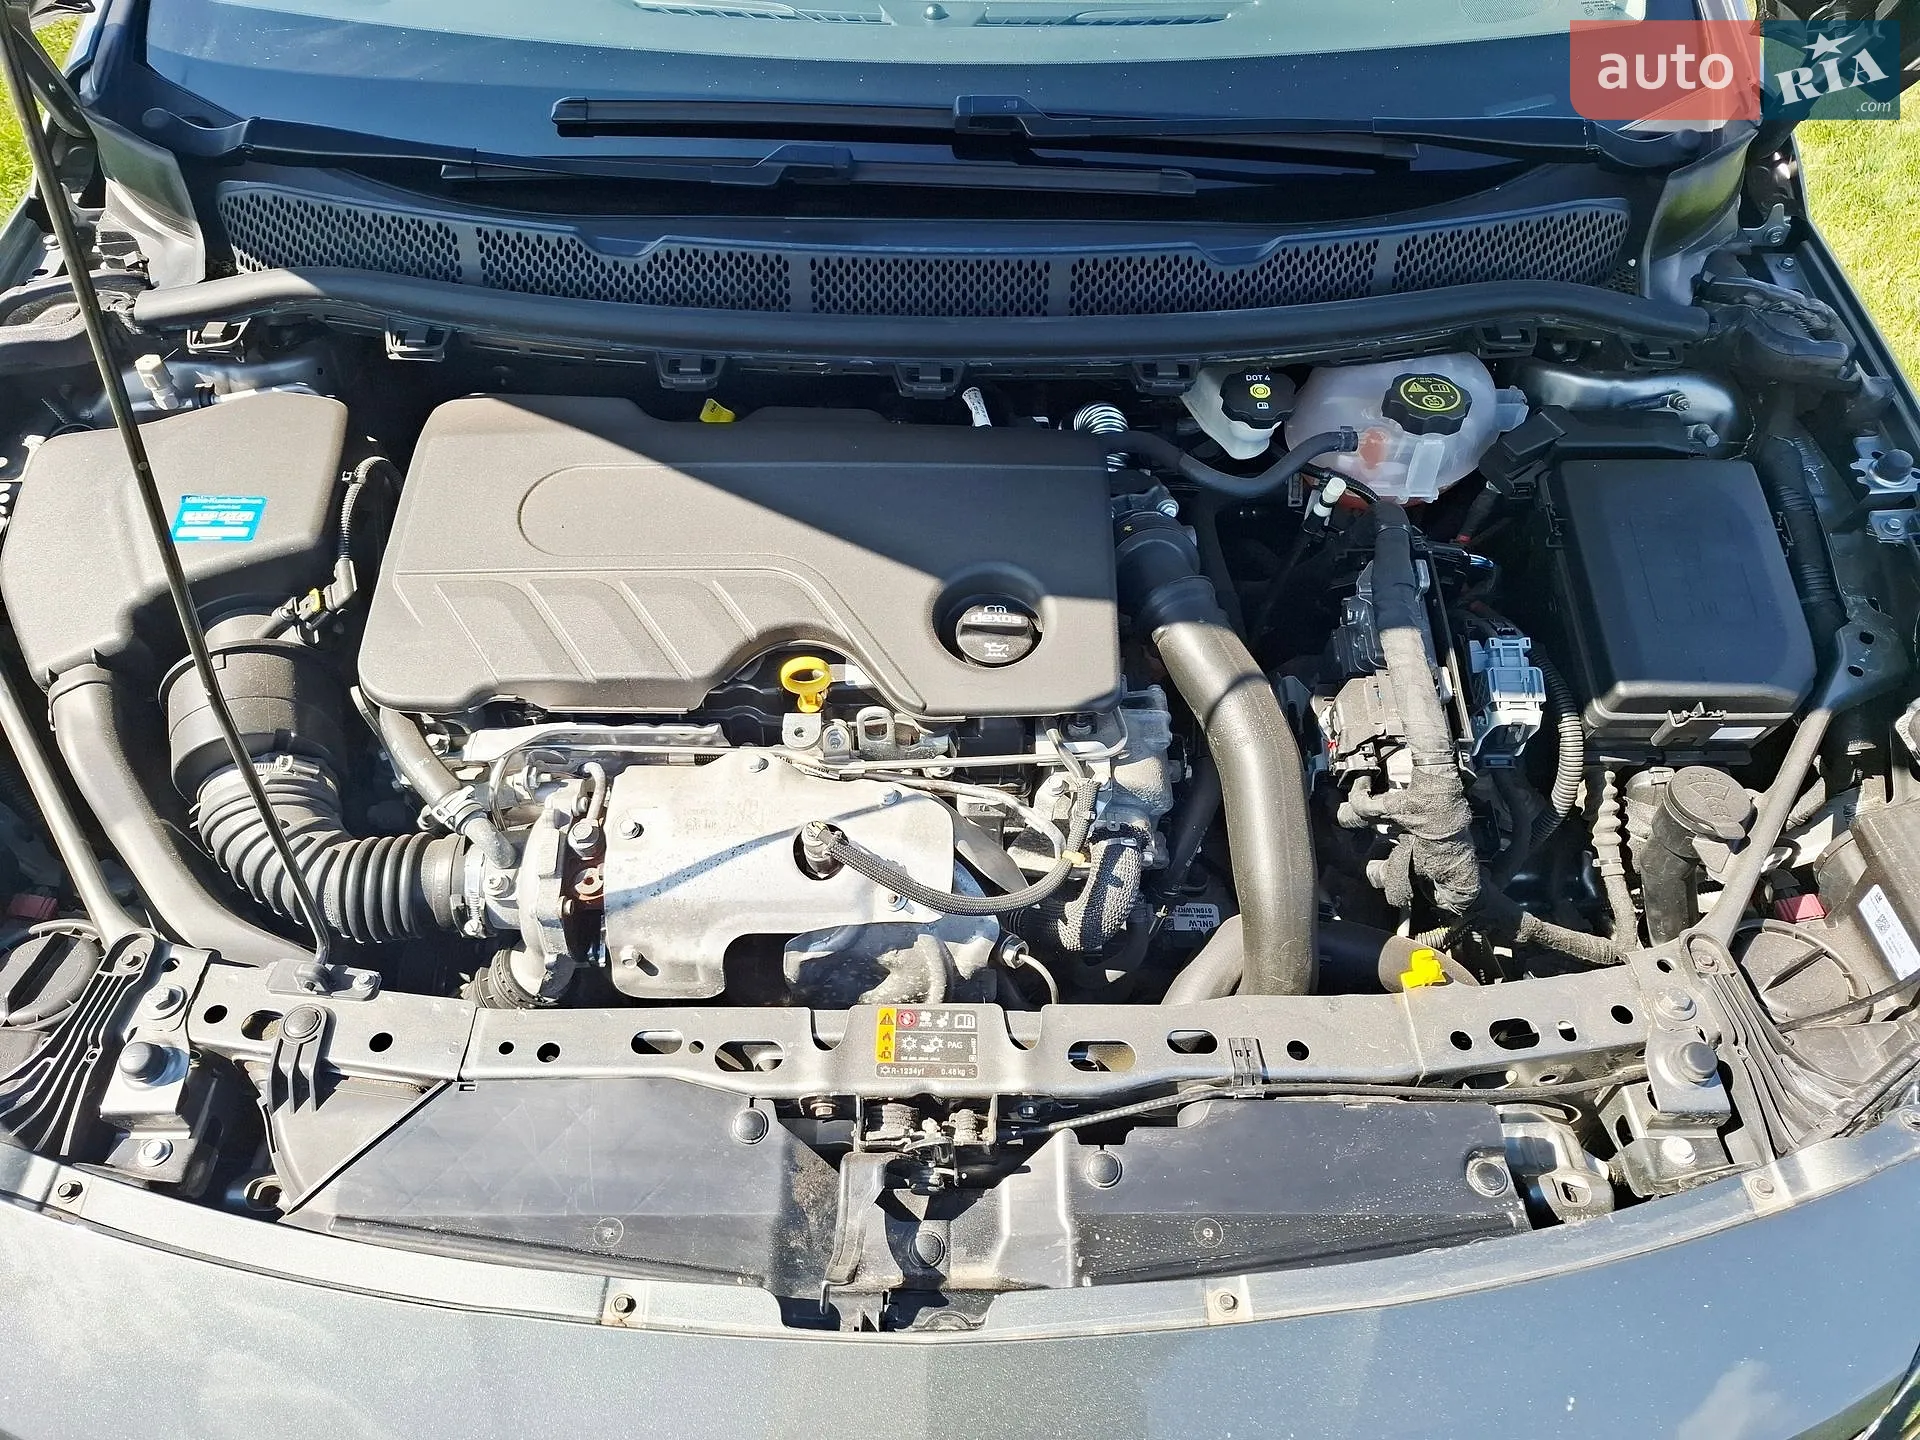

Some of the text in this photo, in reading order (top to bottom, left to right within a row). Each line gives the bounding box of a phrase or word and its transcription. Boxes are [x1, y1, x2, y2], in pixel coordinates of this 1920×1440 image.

[970, 611, 1022, 624] dexos
[947, 1041, 963, 1049] PAG
[891, 1067, 925, 1077] R-1234yf
